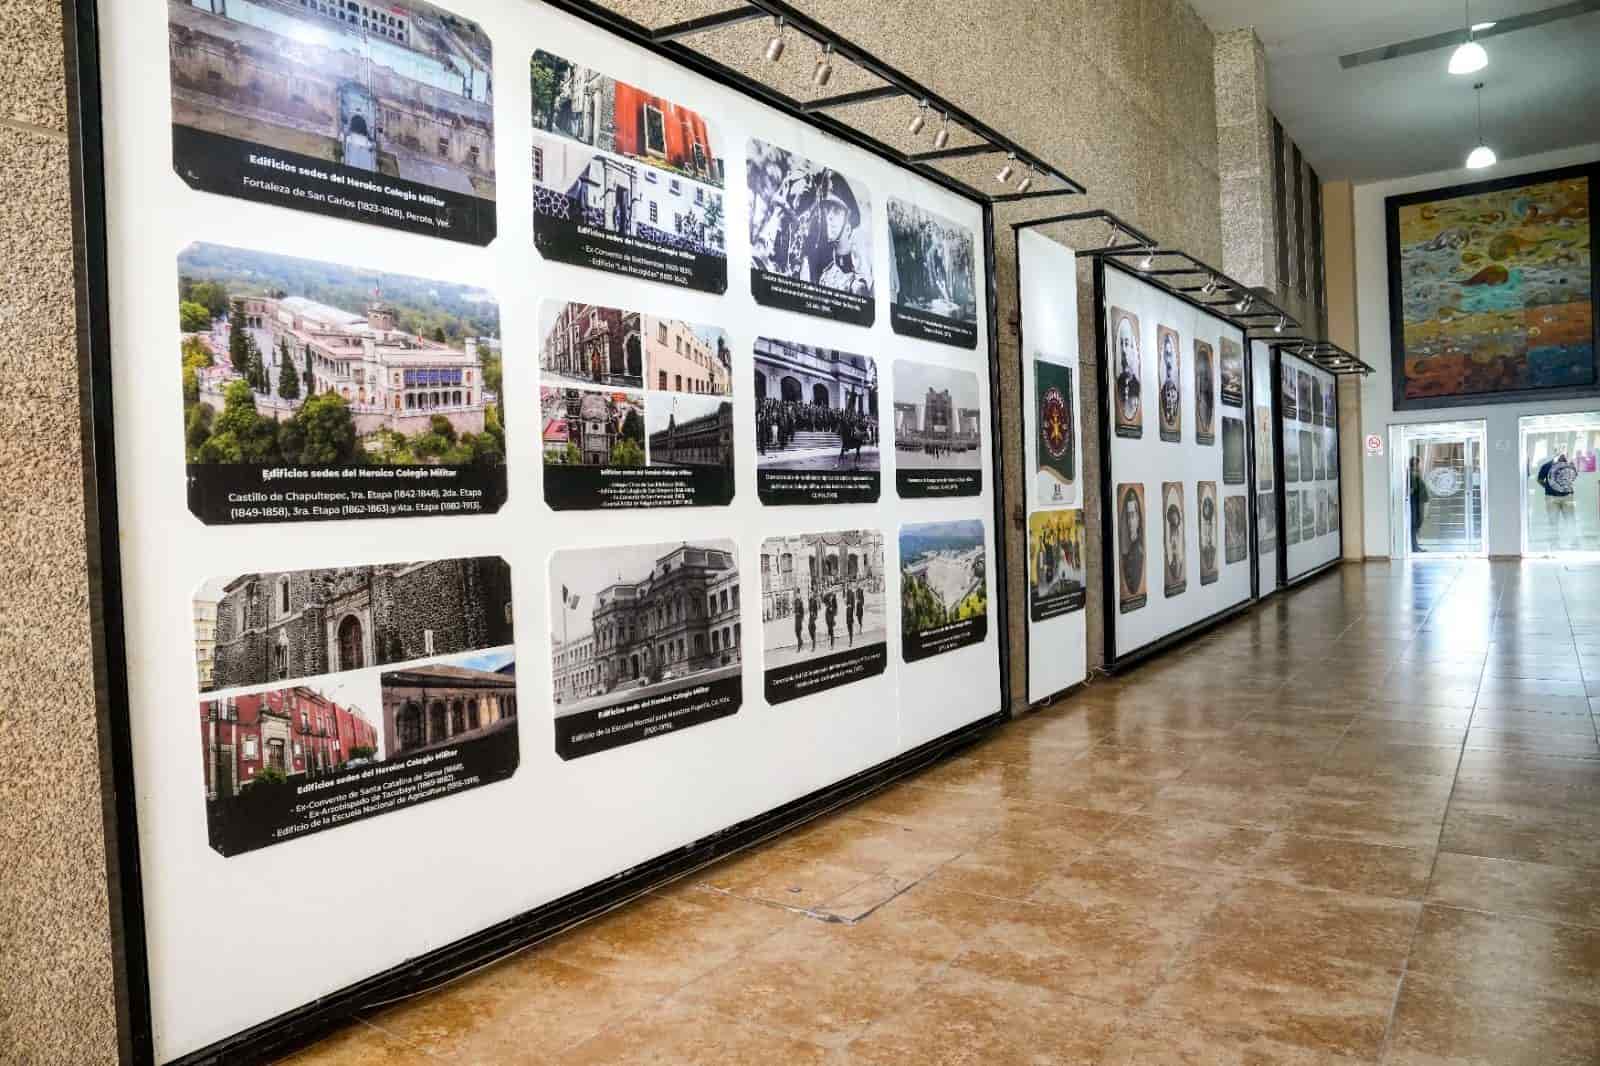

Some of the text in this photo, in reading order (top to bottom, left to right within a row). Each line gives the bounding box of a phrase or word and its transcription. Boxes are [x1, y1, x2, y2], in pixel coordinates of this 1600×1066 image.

[243, 176, 290, 194] Fortaleza
[292, 187, 305, 198] de
[307, 190, 326, 201] San
[327, 194, 356, 207] Carlos
[249, 154, 445, 207] Edificios sedes del Heroico Colegio Militar
[262, 467, 457, 480] Edificios sedes del Heroico Colegio Militar
[228, 492, 268, 502] Castillo
[270, 491, 283, 501] de
[285, 491, 350, 503] Chapultepec,
[367, 490, 392, 501] Etapa
[460, 488, 482, 499] Etapa
[231, 506, 291, 519] (1849-1858),
[312, 505, 340, 516] Etapa
[390, 505, 397, 514] y
[415, 503, 439, 513] Etapa
[297, 749, 458, 795] Edificios sedes del Heroico Colegio Militar
[295, 793, 347, 813] Ex-Convento
[348, 790, 359, 799] de
[360, 785, 381, 796] Santa
[382, 777, 412, 790] Catalina
[382, 786, 416, 799] Tacubaya
[277, 823, 309, 838] Edificio
[311, 819, 321, 828] de
[322, 816, 331, 825] la
[332, 808, 362, 822] Escuela
[363, 799, 396, 814] Nacional
[396, 796, 406, 804] de
